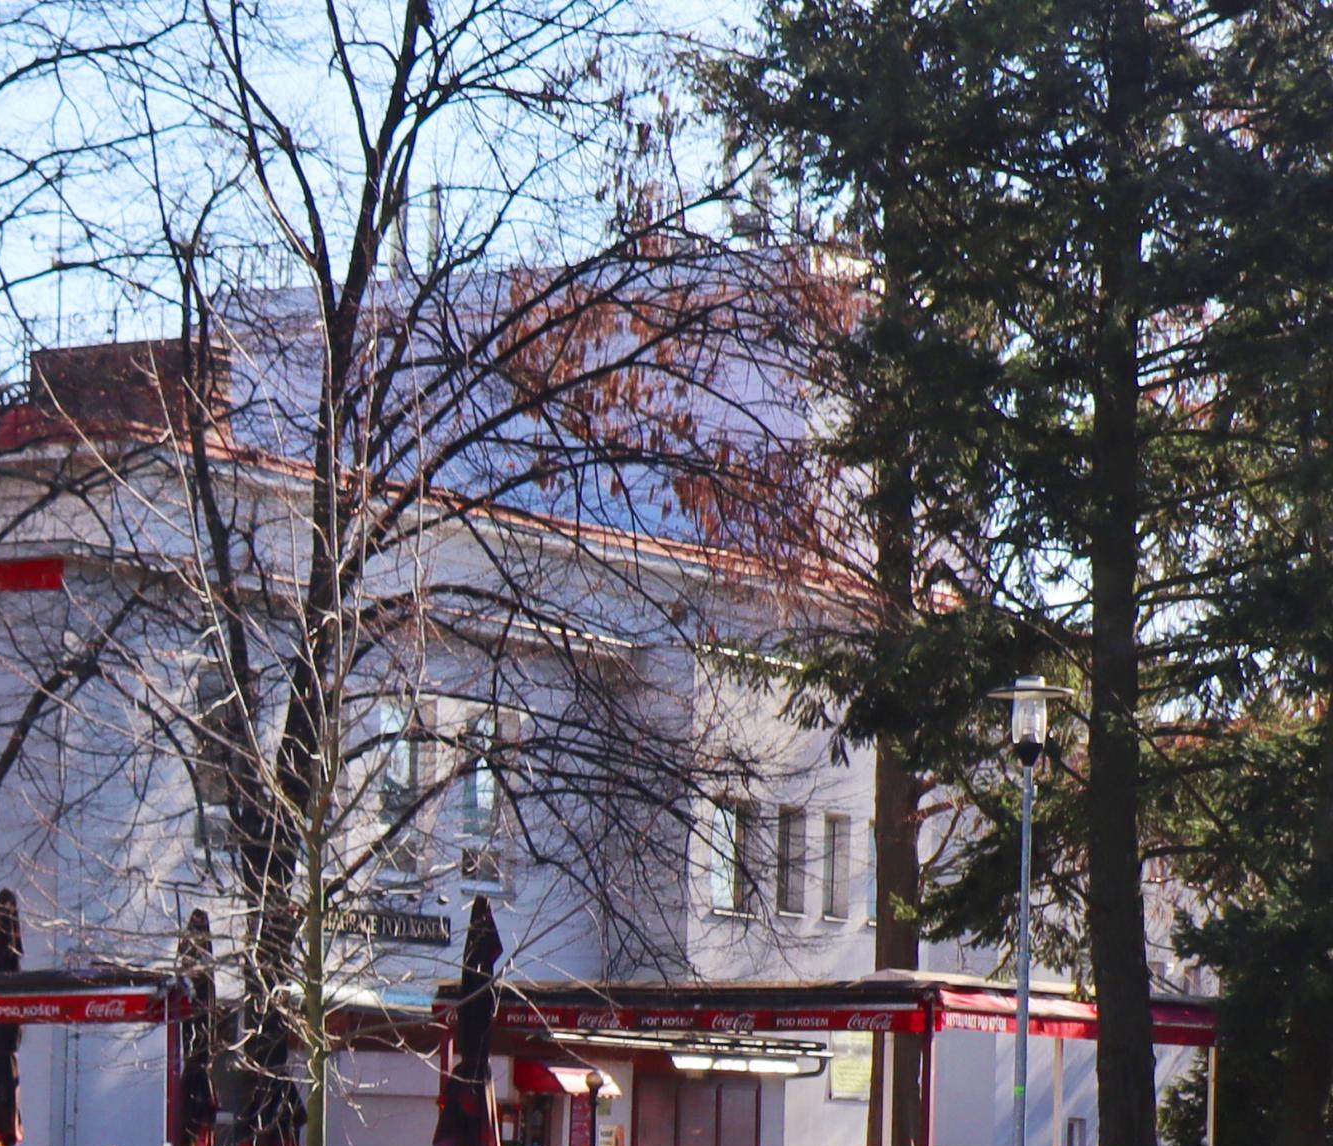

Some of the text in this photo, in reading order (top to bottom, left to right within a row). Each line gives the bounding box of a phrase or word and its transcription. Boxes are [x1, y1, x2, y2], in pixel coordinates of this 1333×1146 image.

[23, 1003, 61, 1017] KOŠEM
[84, 1000, 127, 1018] Coca-Cola
[506, 1013, 528, 1024] POD
[710, 1012, 756, 1030] Coca-Cola
[775, 1015, 829, 1027] POD KOŠEM
[846, 1012, 894, 1031] Coca-Cola
